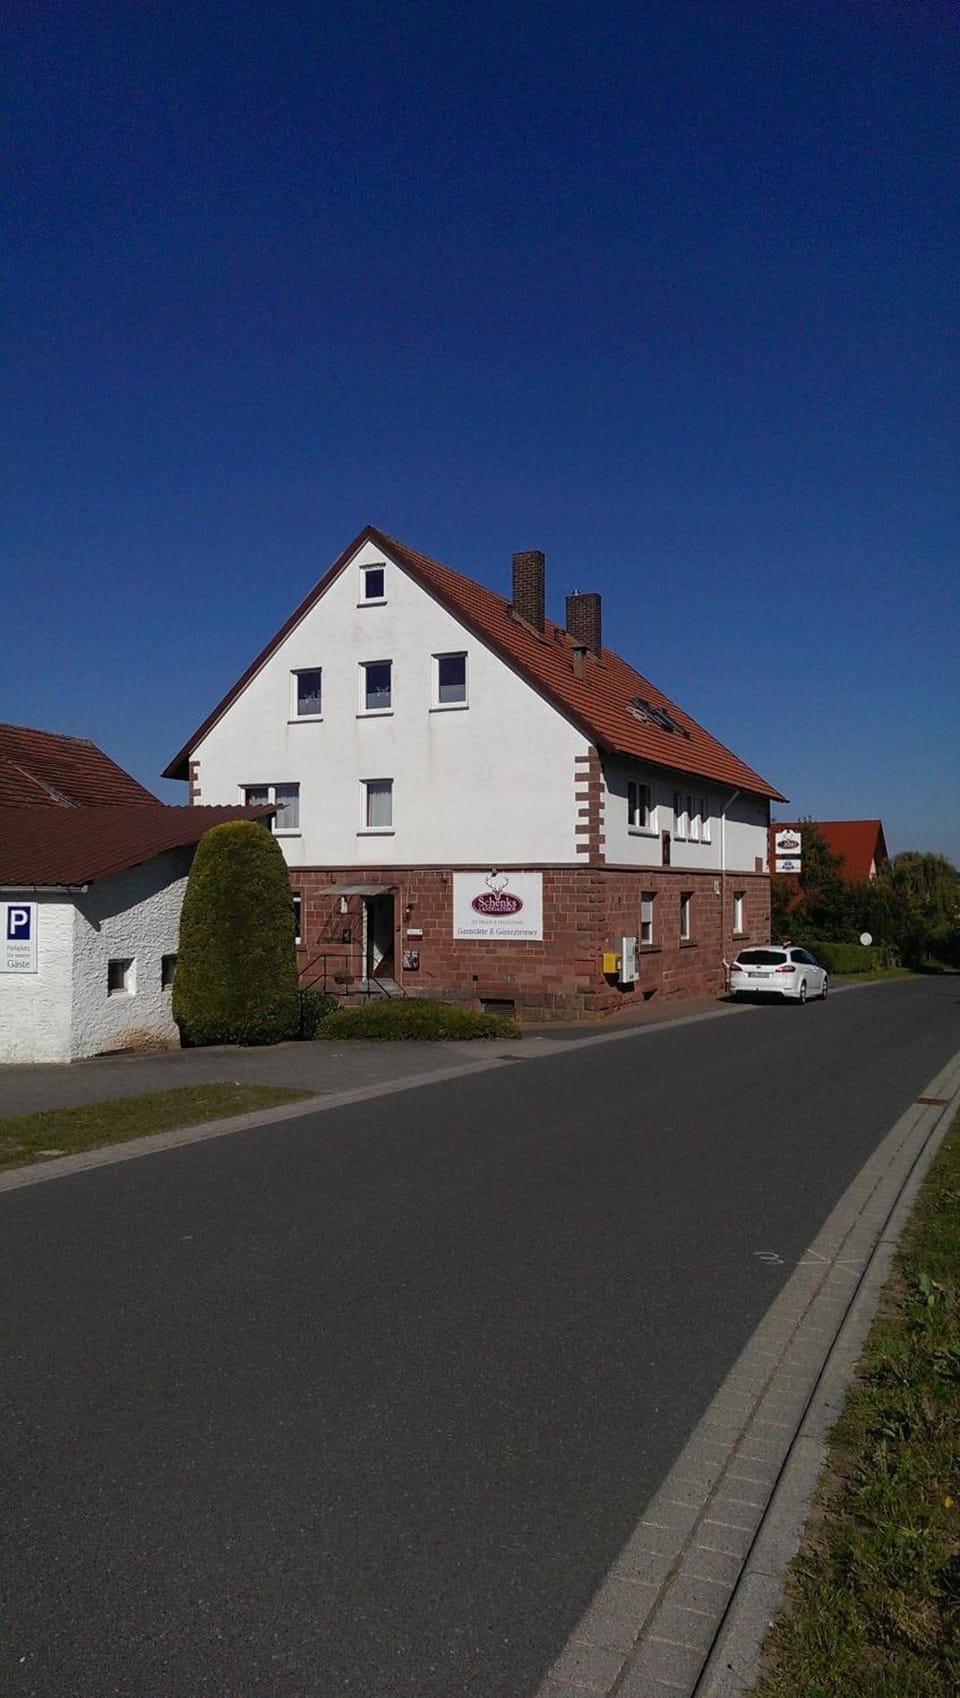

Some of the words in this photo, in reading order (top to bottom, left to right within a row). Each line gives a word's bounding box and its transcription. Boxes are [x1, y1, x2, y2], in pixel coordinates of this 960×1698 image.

[478, 896, 517, 908] Schenks
[10, 910, 28, 935] P
[7, 959, 31, 969] Gäste
